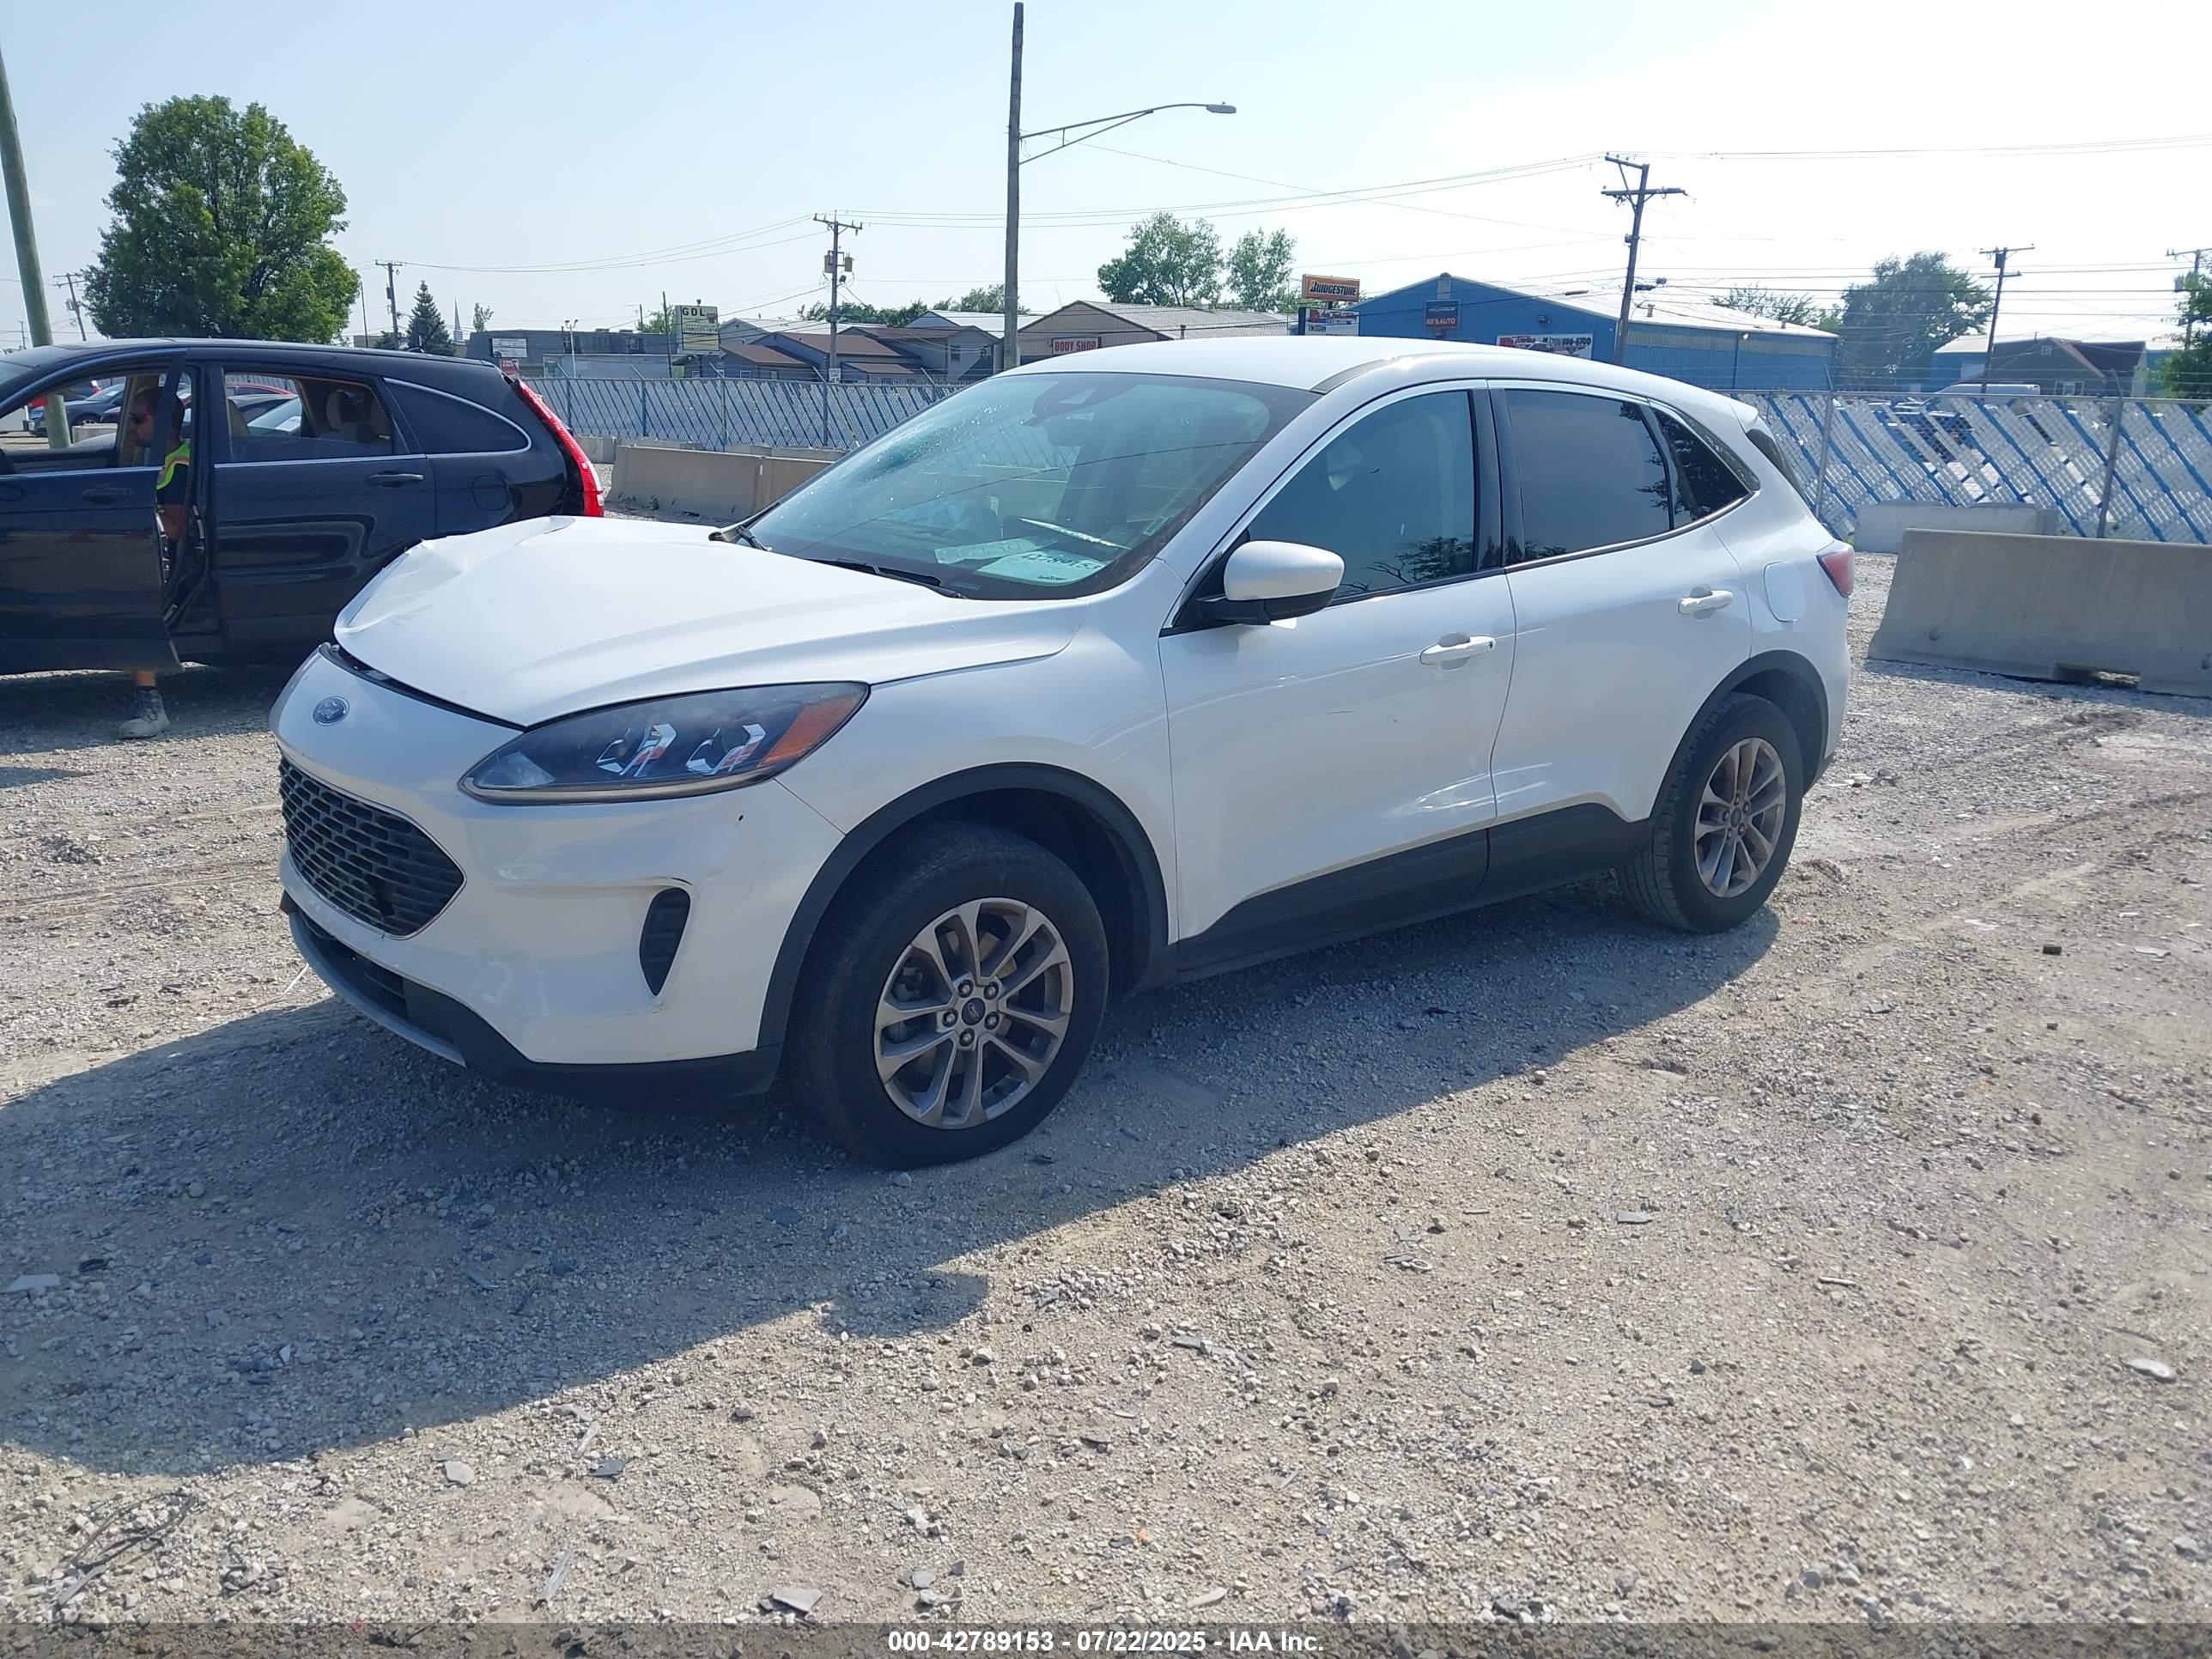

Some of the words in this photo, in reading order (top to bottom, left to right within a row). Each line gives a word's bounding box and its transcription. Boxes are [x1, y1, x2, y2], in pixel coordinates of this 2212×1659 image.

[1310, 282, 1358, 296] BRIDGESTONE
[682, 307, 706, 317] GDL
[1054, 341, 1073, 351] BODY
[1076, 341, 1097, 351] SHOP
